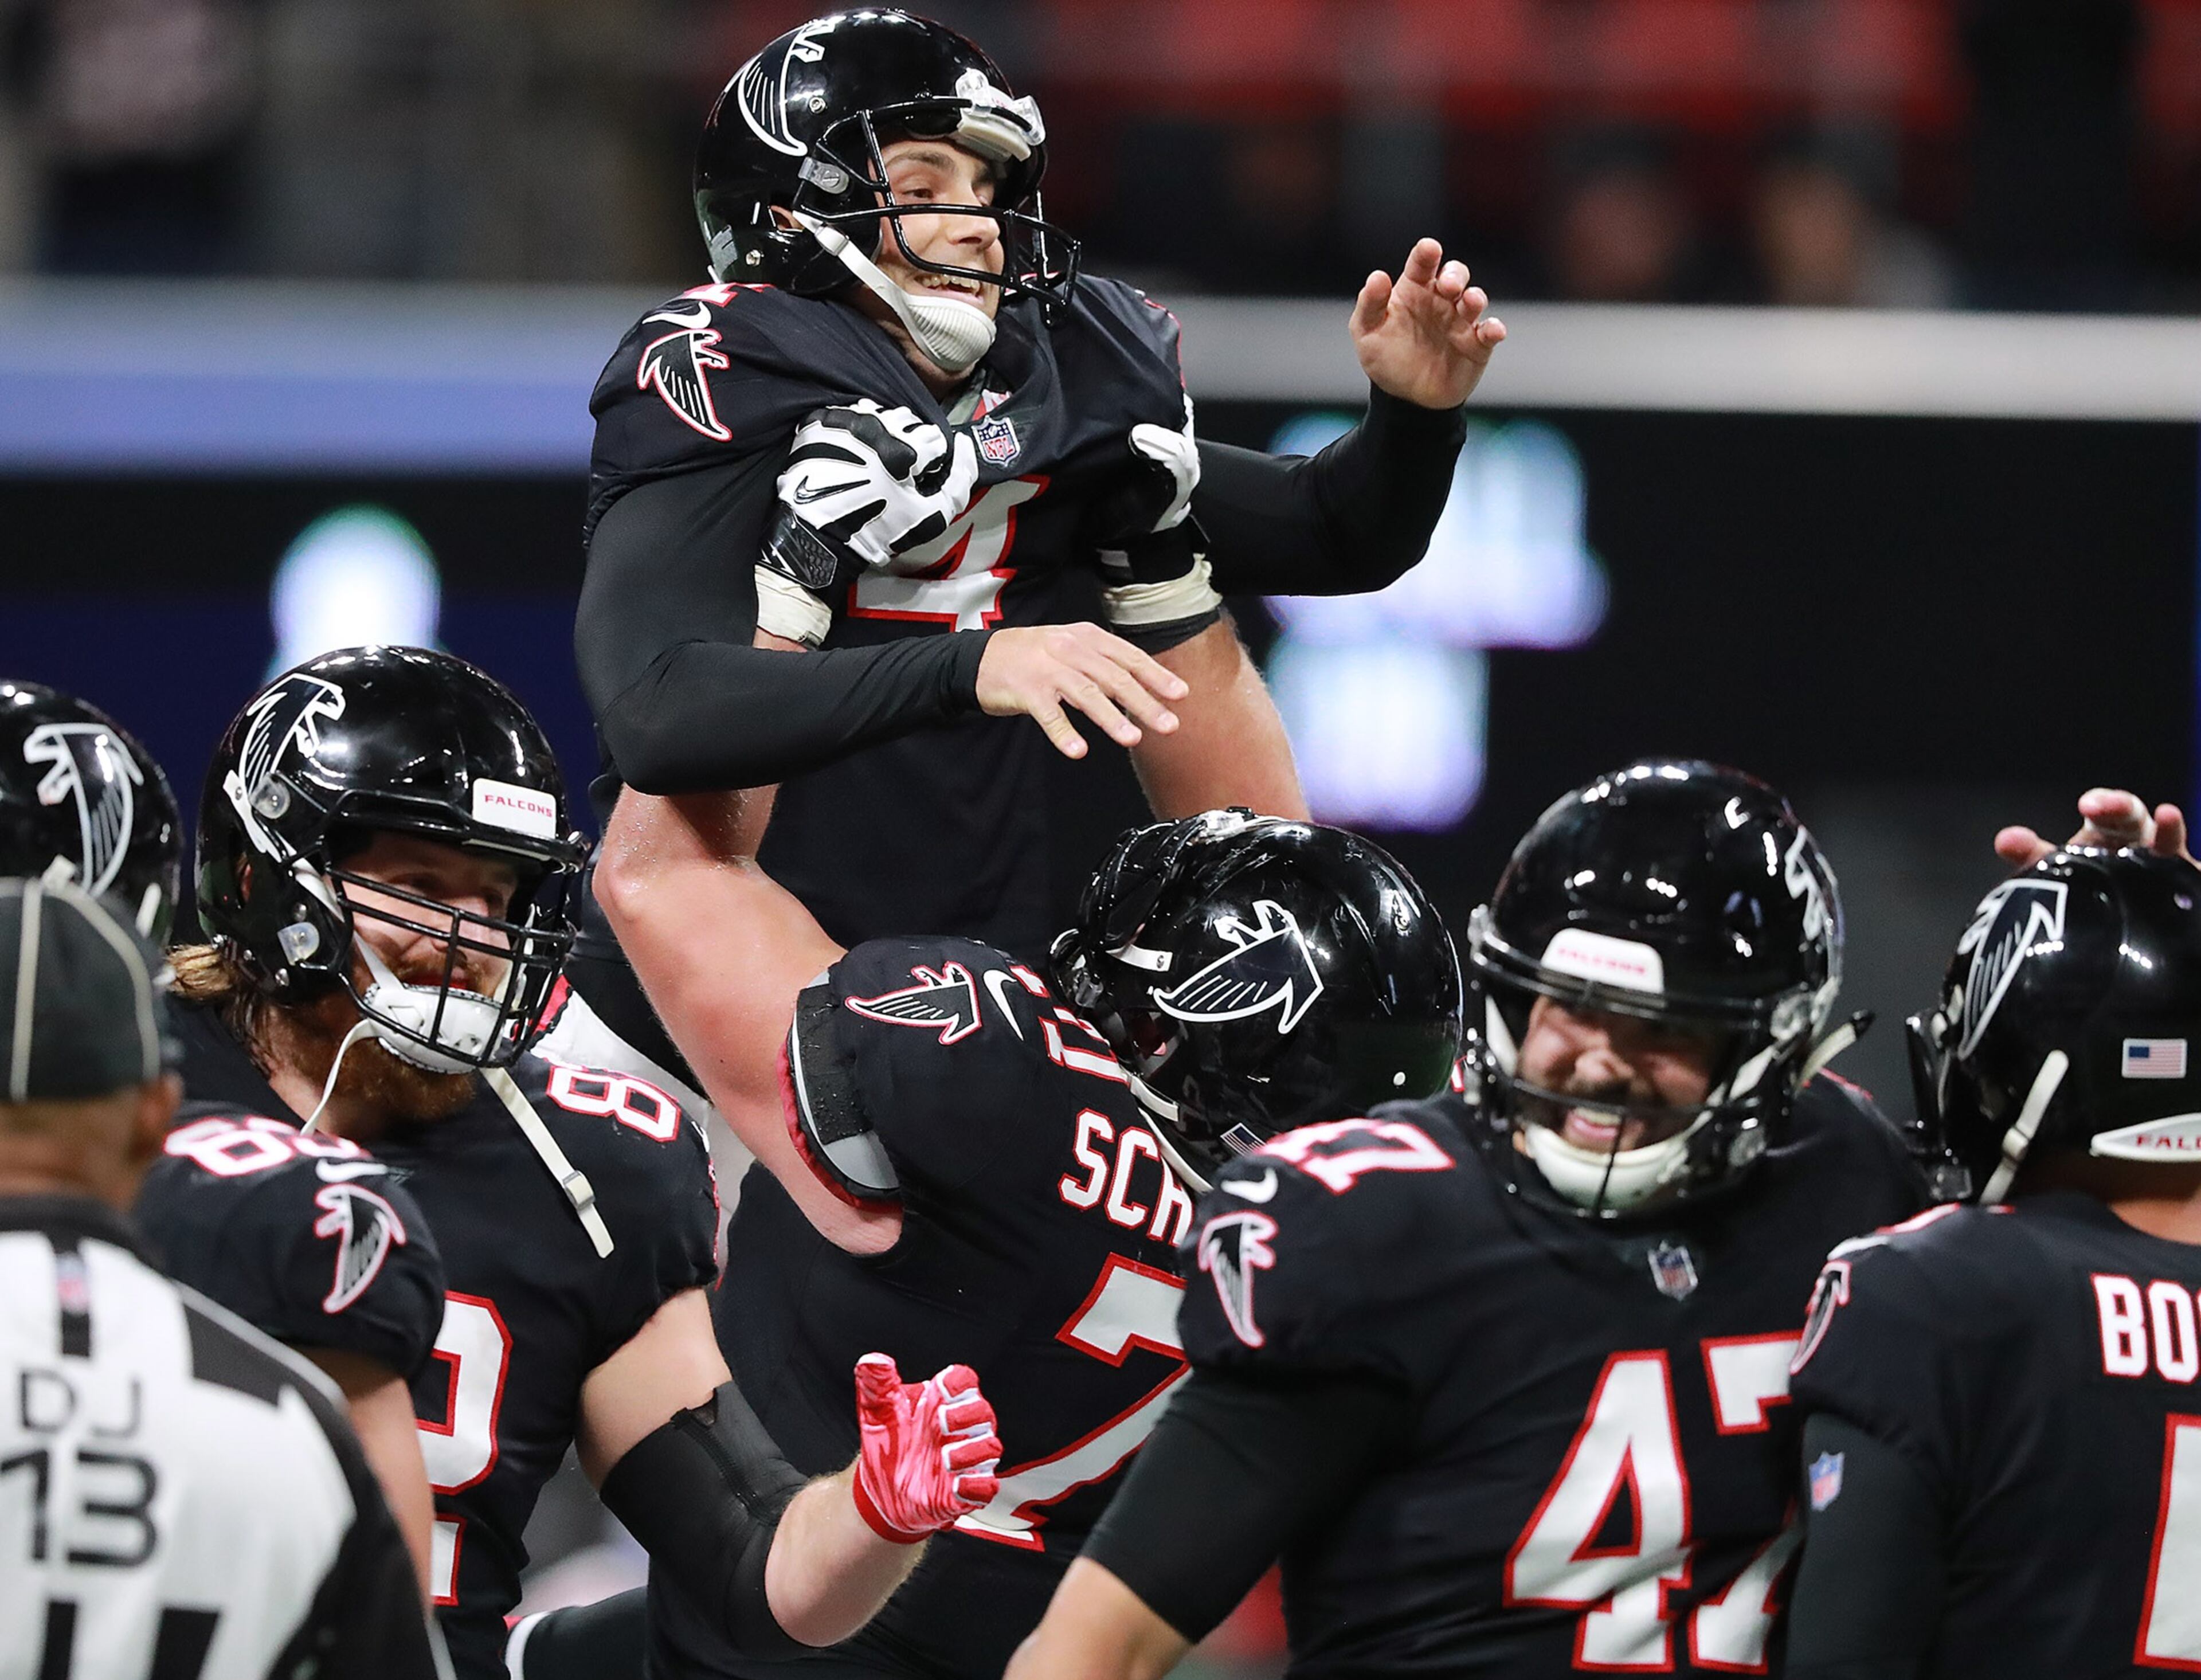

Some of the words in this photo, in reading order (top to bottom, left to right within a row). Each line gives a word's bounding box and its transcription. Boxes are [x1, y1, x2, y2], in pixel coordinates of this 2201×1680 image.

[984, 436, 1017, 459] NFL
[847, 474, 1051, 633] 4
[484, 794, 553, 818] FALCONS
[2089, 1271, 2201, 1385] BO
[0, 1448, 158, 1569] 13
[1502, 1329, 1807, 1675] 47
